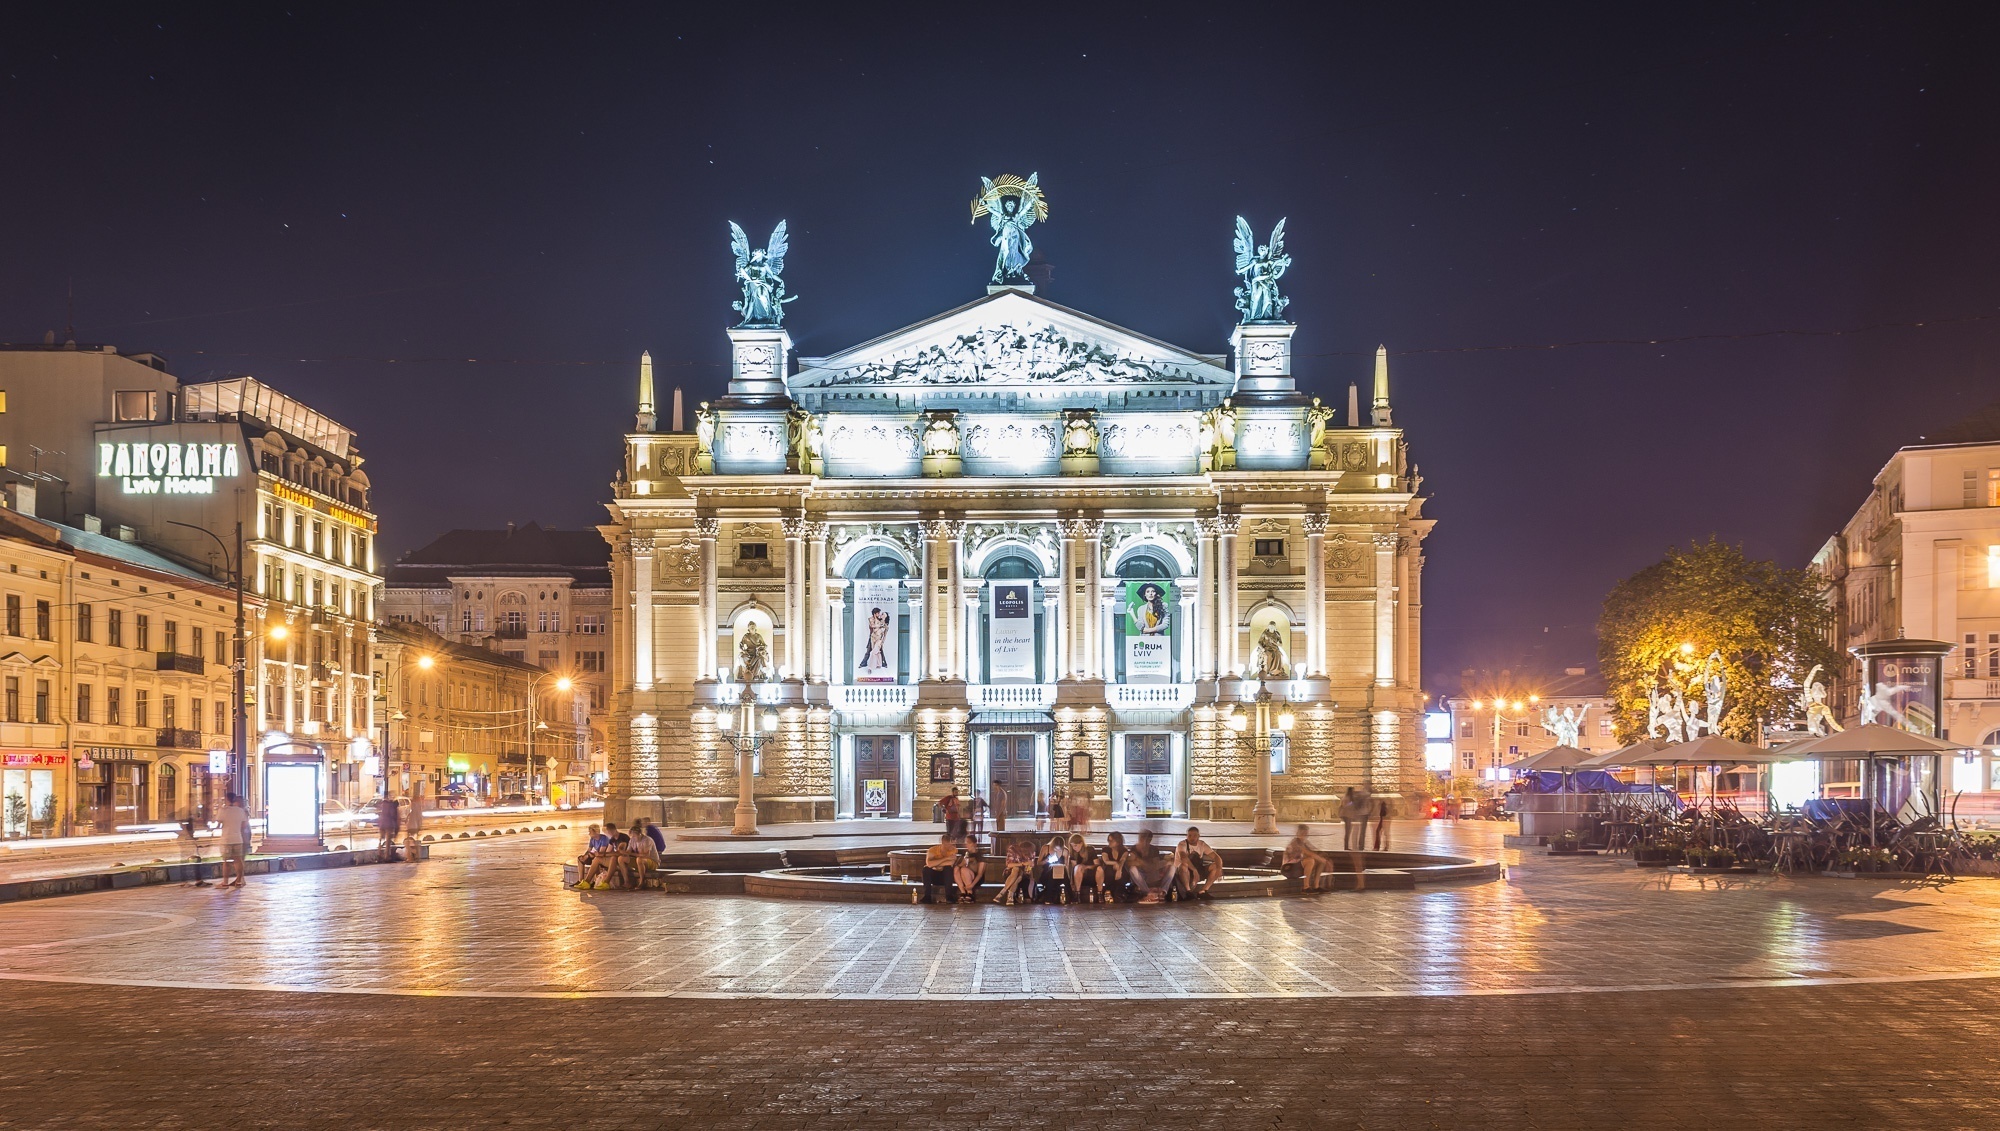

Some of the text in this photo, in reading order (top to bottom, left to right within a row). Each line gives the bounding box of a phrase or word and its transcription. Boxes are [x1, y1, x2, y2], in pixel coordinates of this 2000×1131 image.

[99, 443, 238, 476] PANORAMA
[123, 477, 213, 493] Lviv Hotel
[994, 646, 1002, 654] of
[1134, 641, 1162, 650] FORUM
[1901, 664, 1931, 674] moto
